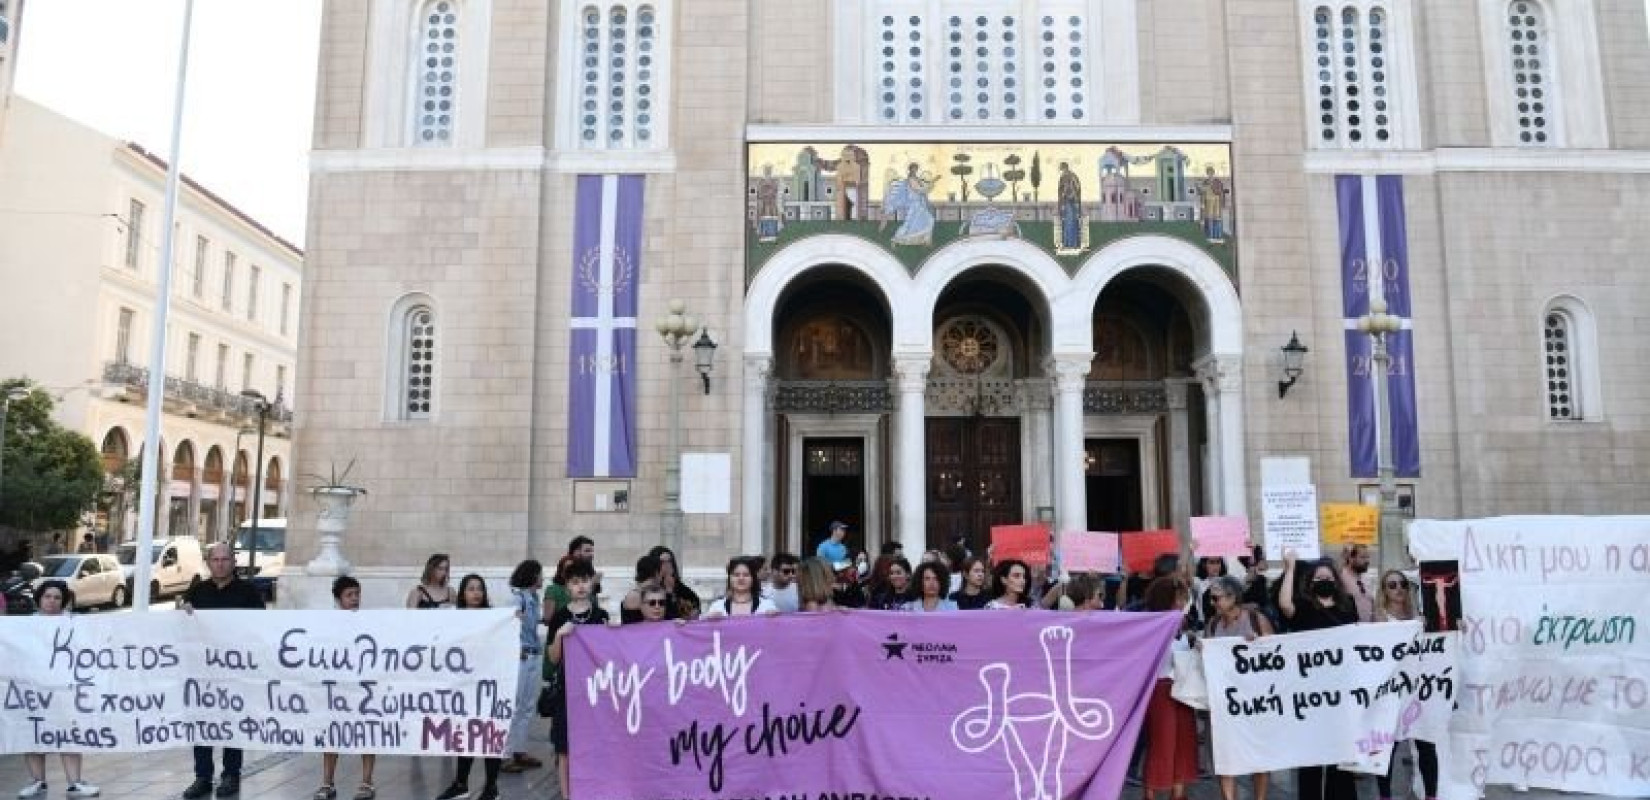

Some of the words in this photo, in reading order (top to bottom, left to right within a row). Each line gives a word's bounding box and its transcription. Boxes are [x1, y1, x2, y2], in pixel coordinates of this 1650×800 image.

[205, 647, 259, 671] και
[1231, 644, 1286, 674] δικό
[1297, 647, 1343, 678] μου
[1353, 644, 1385, 661] το
[3, 679, 53, 712] Δεν
[267, 680, 309, 714] Για
[321, 680, 353, 712] Τα
[587, 660, 655, 735] my
[664, 630, 762, 717] body
[1225, 683, 1284, 716] δική
[1293, 689, 1341, 721] μου
[1351, 687, 1369, 709] η
[27, 716, 118, 749] Τομέας
[135, 716, 235, 746] Ισότητας
[669, 719, 740, 793] my
[745, 701, 861, 757] choice
